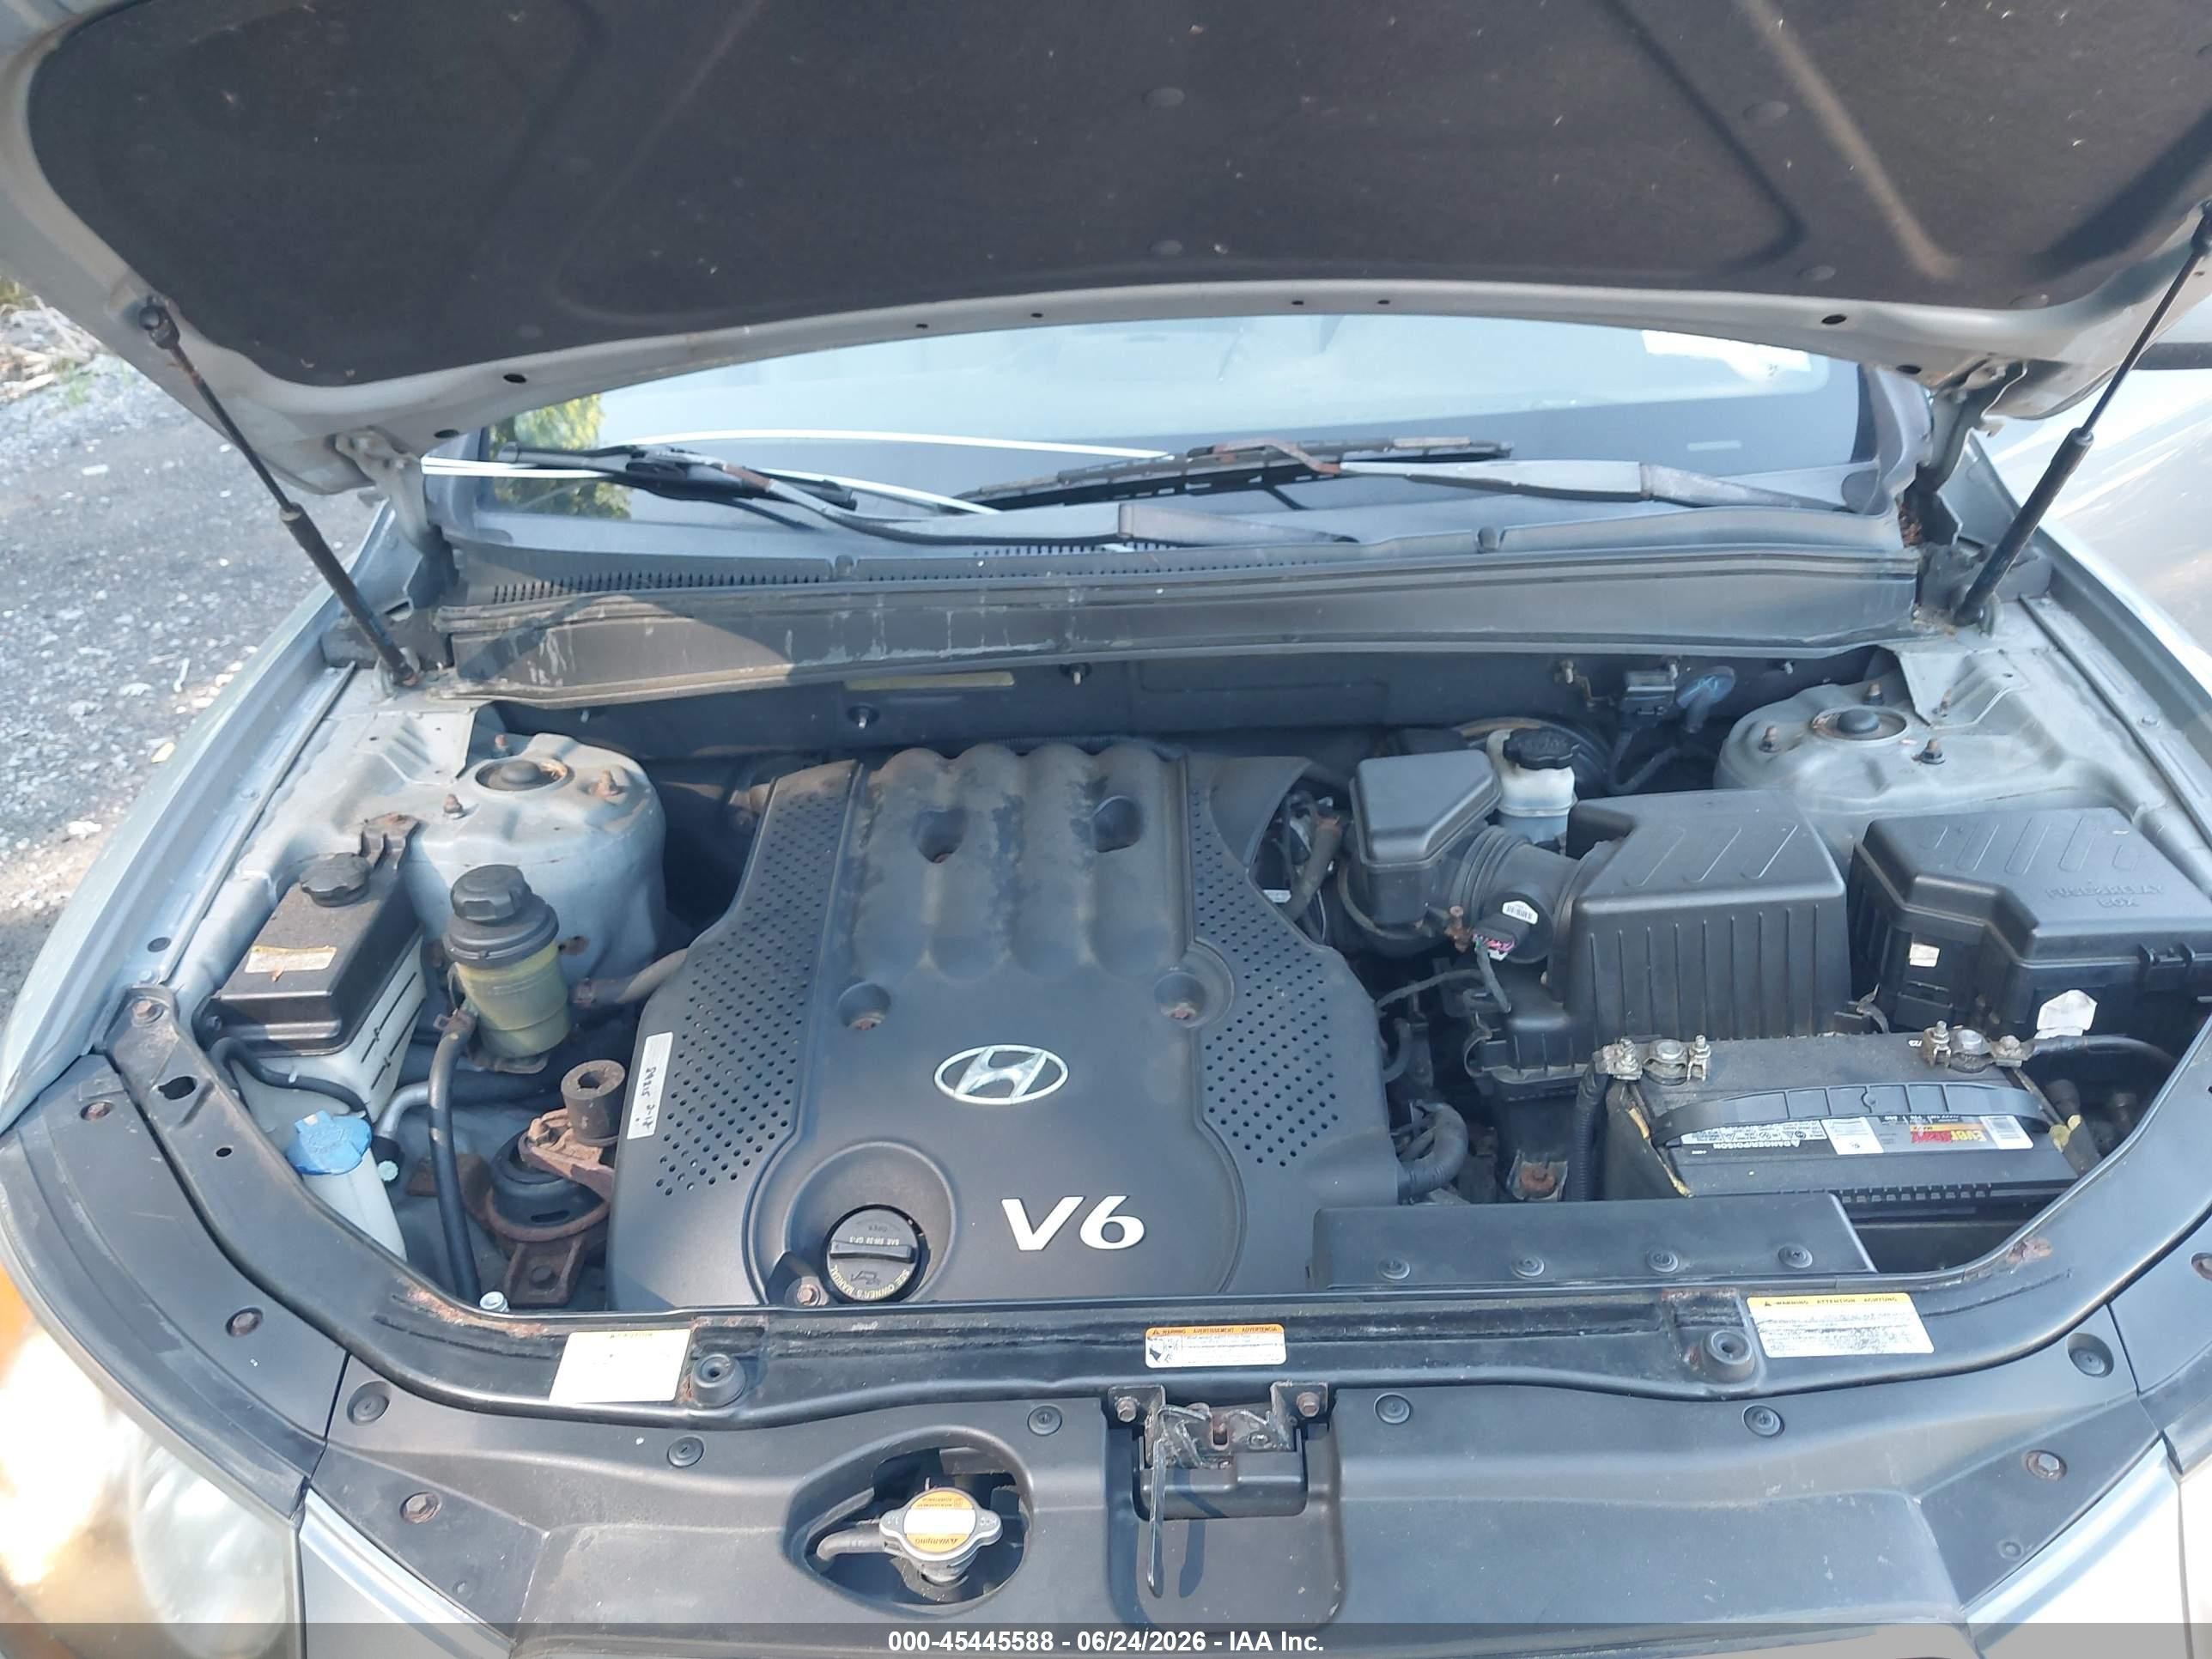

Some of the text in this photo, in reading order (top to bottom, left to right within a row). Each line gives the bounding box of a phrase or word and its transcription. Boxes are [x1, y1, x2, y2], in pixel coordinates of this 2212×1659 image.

[1001, 1194, 1146, 1251] V6
[829, 1264, 854, 1296] MANUAL
[894, 1268, 911, 1286] SEE
